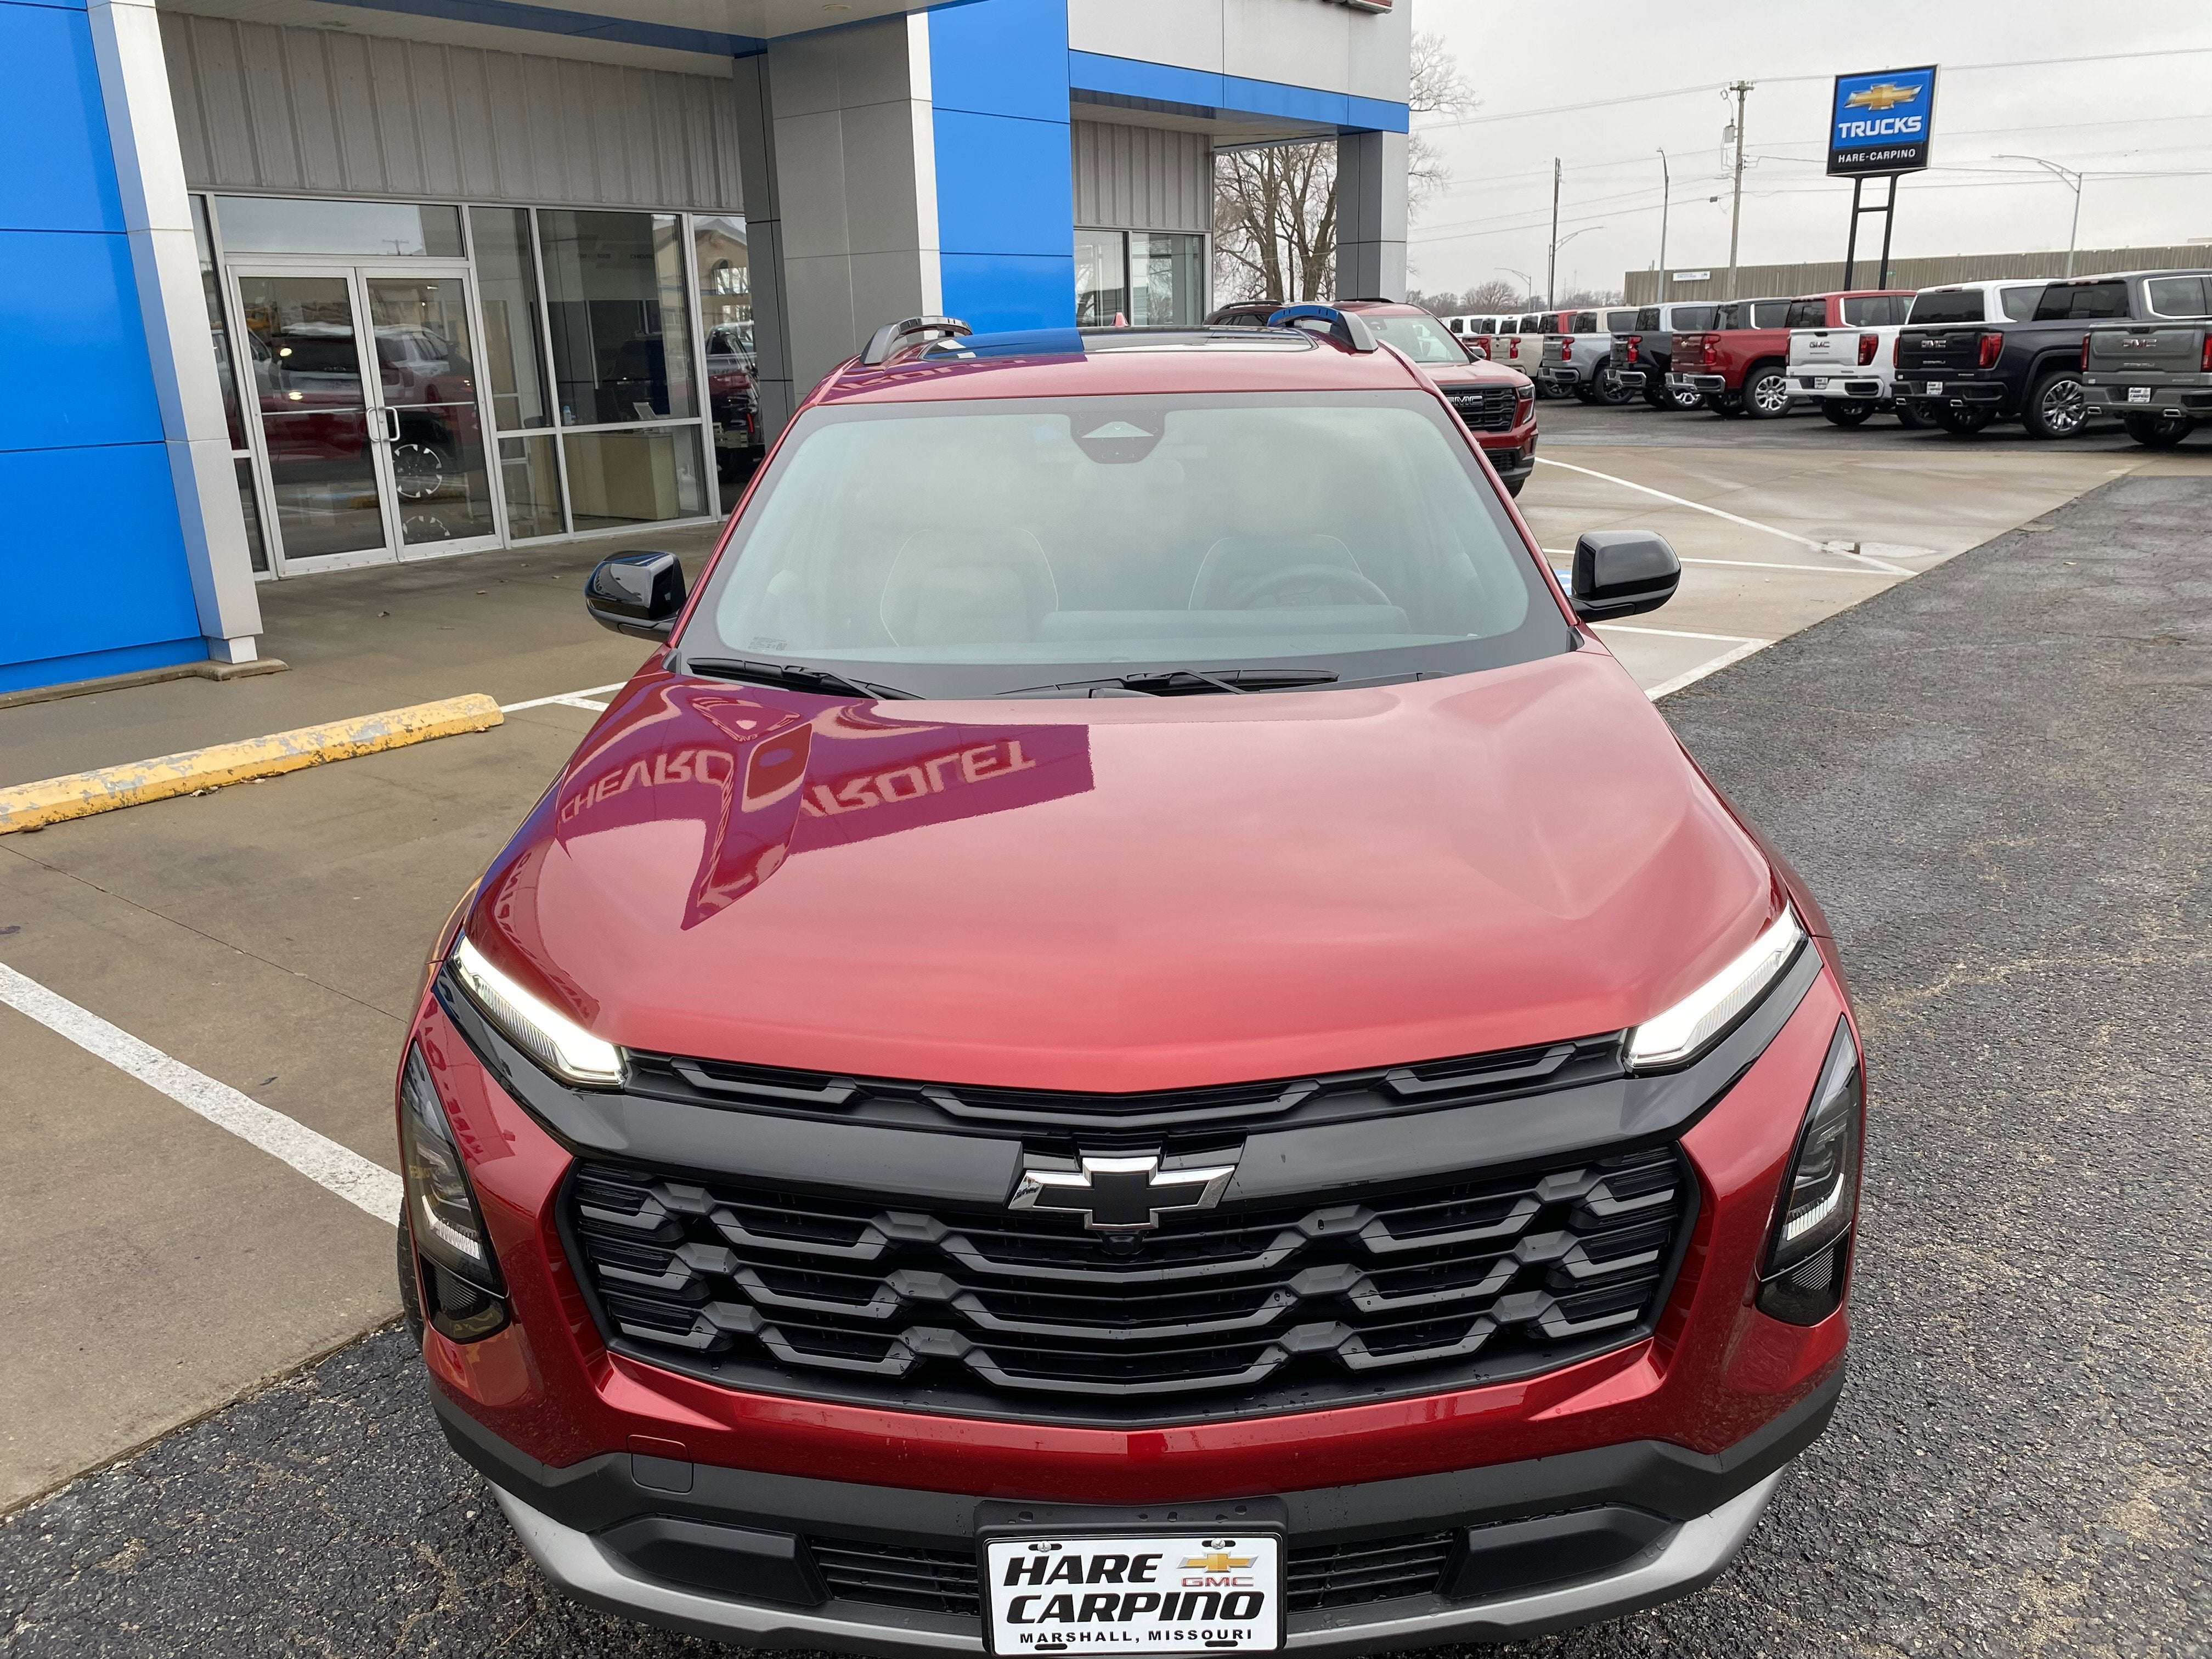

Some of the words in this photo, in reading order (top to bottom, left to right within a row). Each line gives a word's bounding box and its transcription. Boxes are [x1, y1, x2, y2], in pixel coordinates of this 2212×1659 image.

[1838, 115, 1922, 139] TRUCKS
[1838, 148, 1916, 163] HARE-CARPINO
[2122, 338, 2157, 349] GMC
[1003, 1553, 1163, 1587] HARE
[1181, 1576, 1254, 1587] GMC
[1006, 1591, 1265, 1624] CARPINO
[1019, 1630, 1139, 1644] MARSHALL,
[1148, 1628, 1252, 1641] MISSOURI
